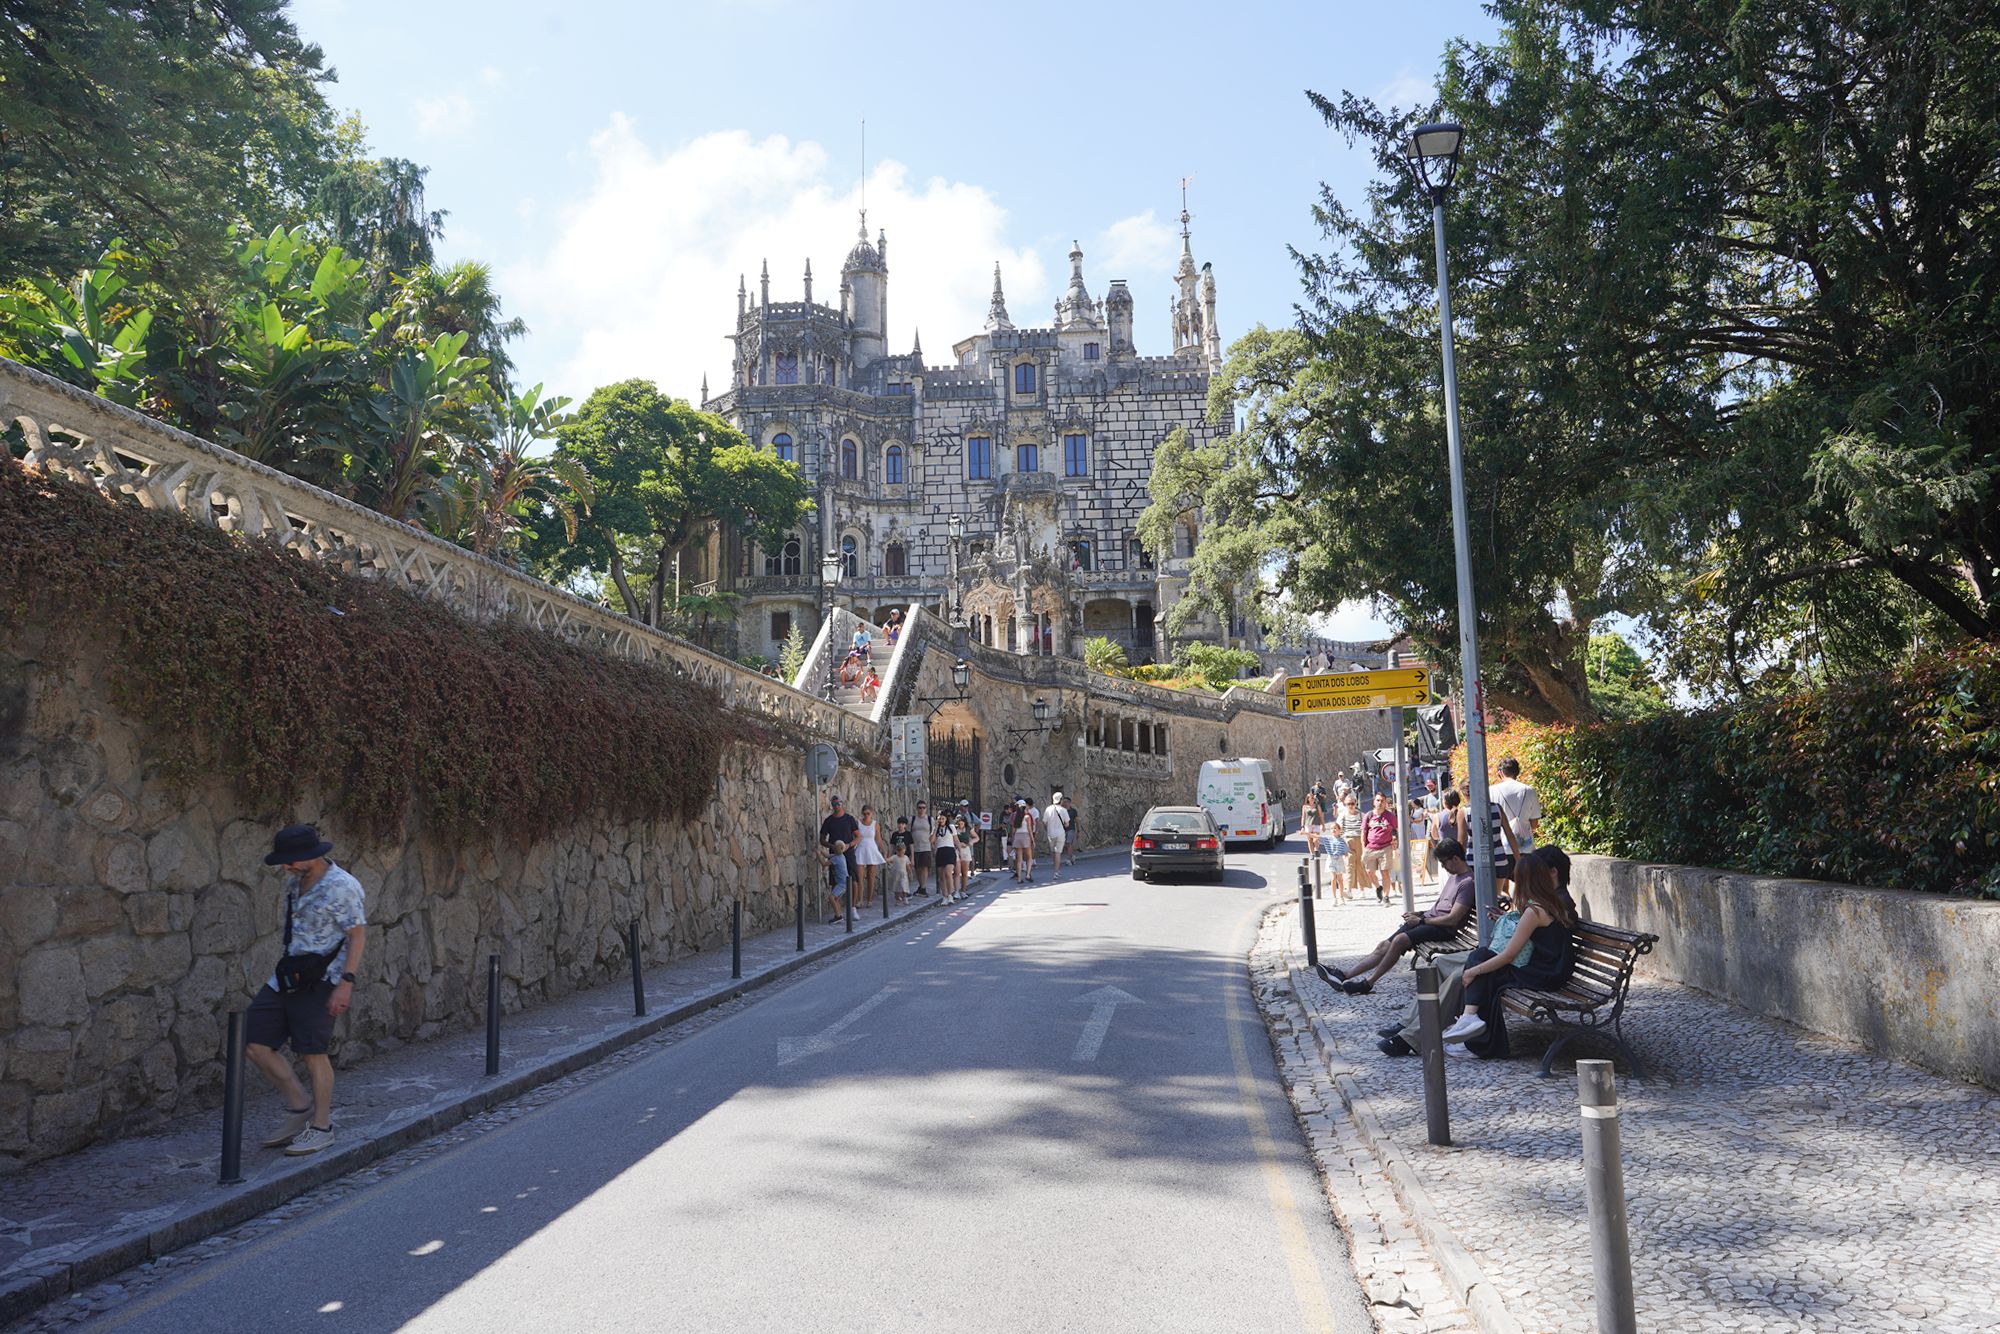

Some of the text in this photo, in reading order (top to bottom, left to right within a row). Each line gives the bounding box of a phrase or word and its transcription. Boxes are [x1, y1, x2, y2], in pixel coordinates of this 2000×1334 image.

[1306, 675, 1370, 689] QUINTA DOS LOBOS
[1292, 695, 1371, 711] P QUINTA DOS LOBOS
